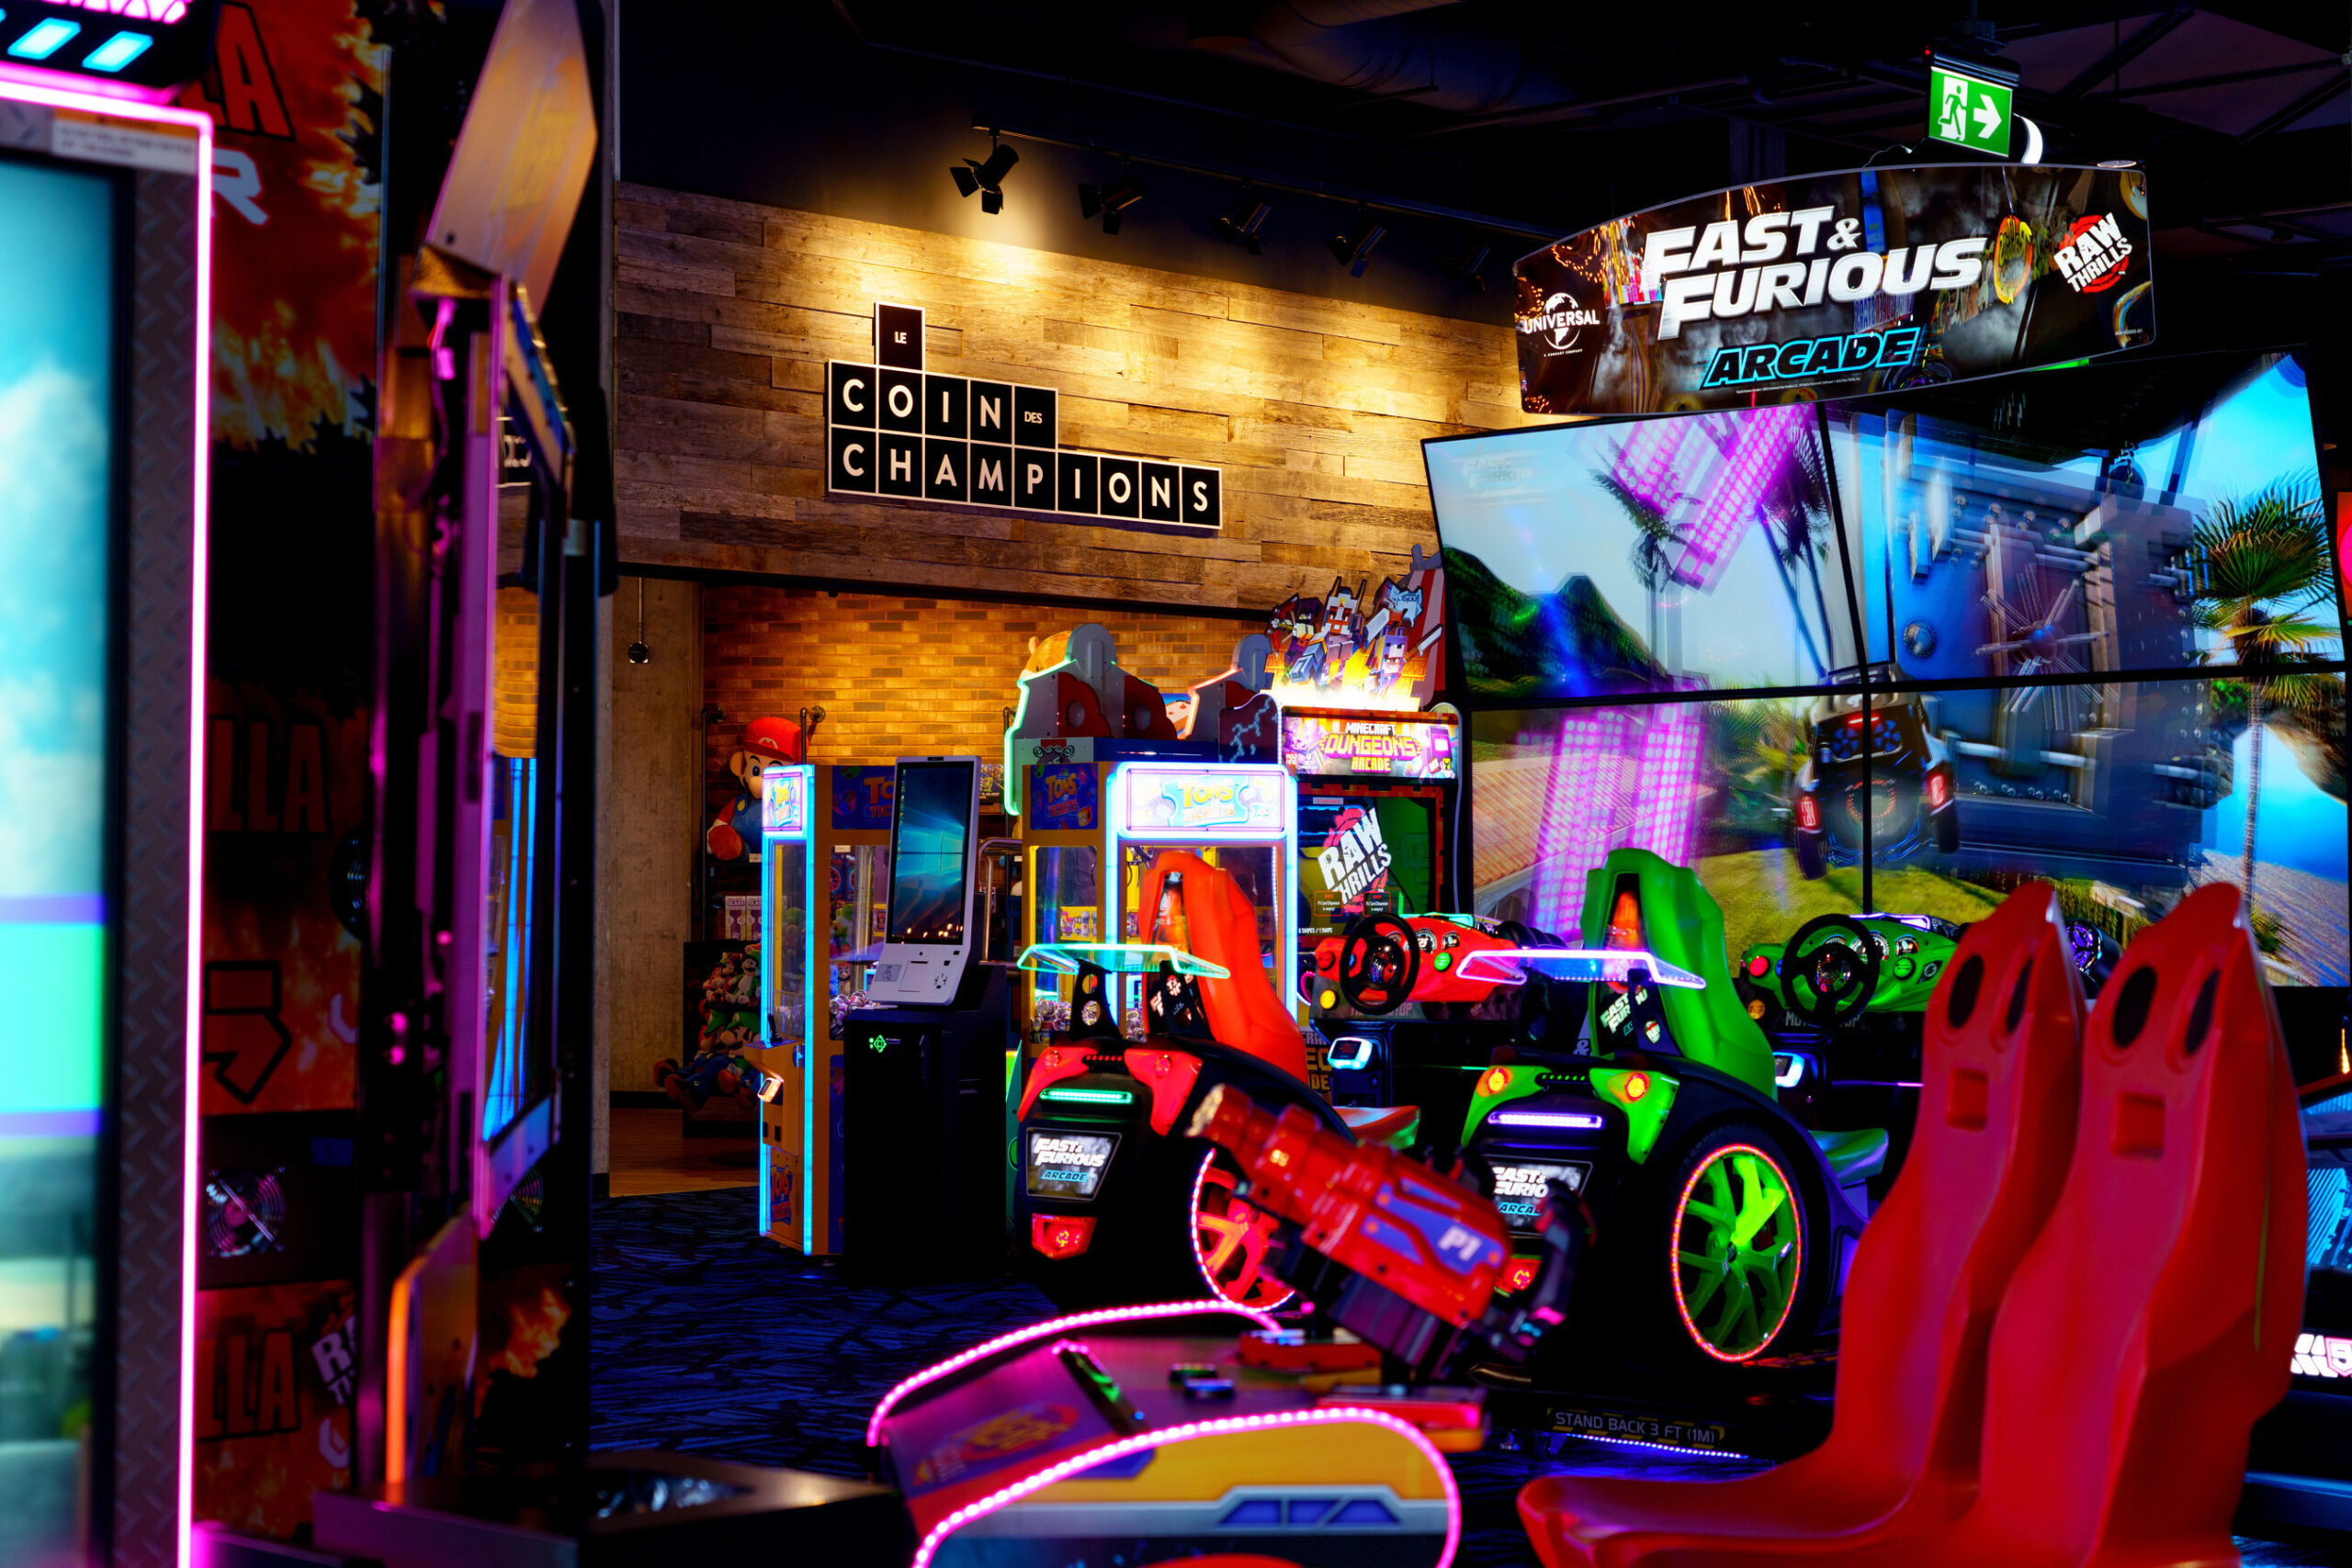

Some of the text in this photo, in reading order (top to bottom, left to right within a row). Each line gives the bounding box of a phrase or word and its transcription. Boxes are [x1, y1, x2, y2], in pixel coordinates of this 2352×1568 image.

[1642, 206, 1835, 287] FAST
[1826, 218, 1862, 251] &
[2053, 212, 2124, 278] RAW
[2067, 237, 2132, 293] THRILLS
[1657, 237, 1988, 341] FURIOUS
[894, 331, 908, 345] LE
[1523, 310, 1600, 334] UNIVERSAL
[1702, 326, 1921, 389] ARCADE
[842, 378, 1043, 430] COIN DES
[842, 443, 1208, 513] CHAMPIONS
[1345, 722, 1396, 736] MINECRAFT
[1324, 734, 1420, 761] DUNGEONS
[1351, 756, 1392, 773] ARCADE
[1046, 773, 1077, 804] TONS
[1177, 780, 1234, 808] TONS
[1317, 807, 1383, 890] RAW
[1332, 843, 1392, 905] THRILLS
[1034, 1137, 1080, 1154] FAST
[1035, 1150, 1106, 1168] FURIOUS
[1040, 1169, 1089, 1182] ARCADE
[1555, 1411, 1715, 1444] STAND BACK 3 FT (1M)
